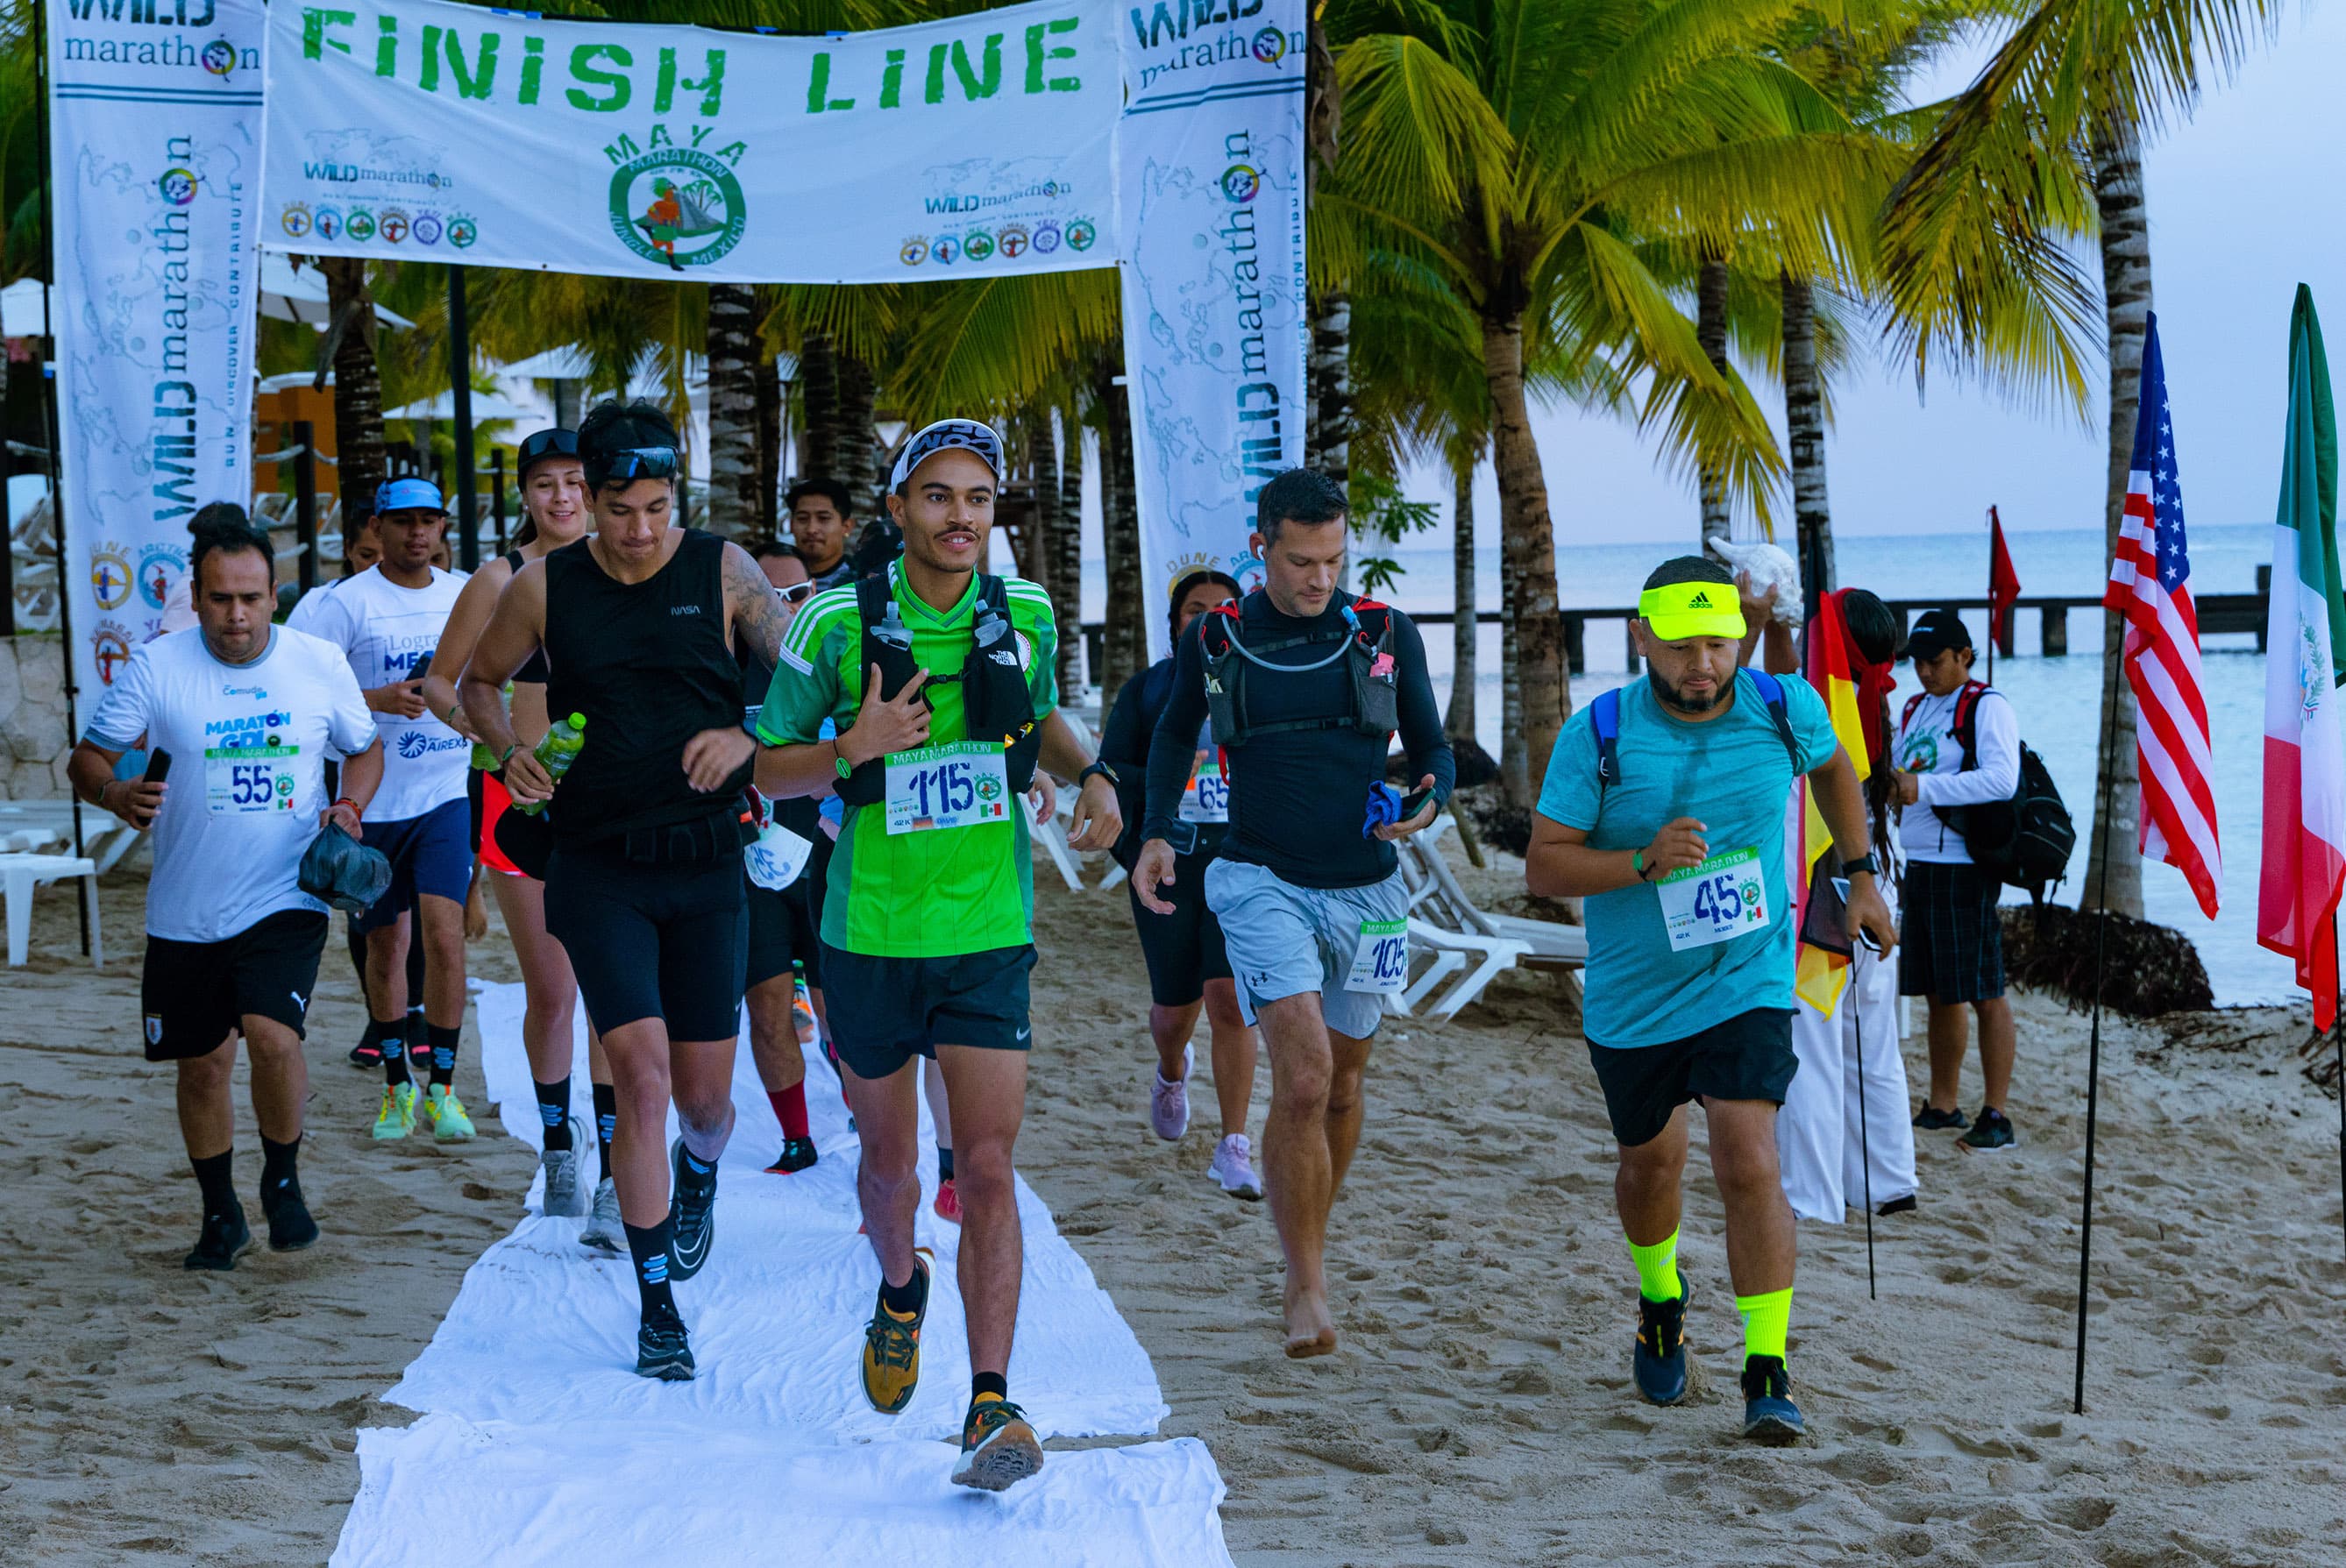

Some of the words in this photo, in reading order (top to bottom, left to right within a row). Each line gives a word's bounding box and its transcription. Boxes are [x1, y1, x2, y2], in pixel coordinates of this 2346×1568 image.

[65, 35, 260, 75] marathon
[603, 124, 748, 167] MAYA
[629, 150, 729, 178] MARATHON
[610, 211, 656, 259] JUNGLE
[692, 216, 745, 266] MEXICO
[224, 426, 236, 468] RUN
[1166, 552, 1220, 573] DUNE
[671, 605, 700, 616] NASA
[205, 709, 291, 735] MARATÓN
[893, 751, 928, 764] MAYA
[929, 742, 992, 759] MARATHON
[232, 765, 273, 805] 55
[909, 763, 974, 815] 115
[1198, 777, 1229, 809] 65
[1694, 851, 1748, 875] MARATHON
[1694, 874, 1742, 925] 45
[1367, 925, 1390, 933] MAYA
[1372, 937, 1405, 978] 105
